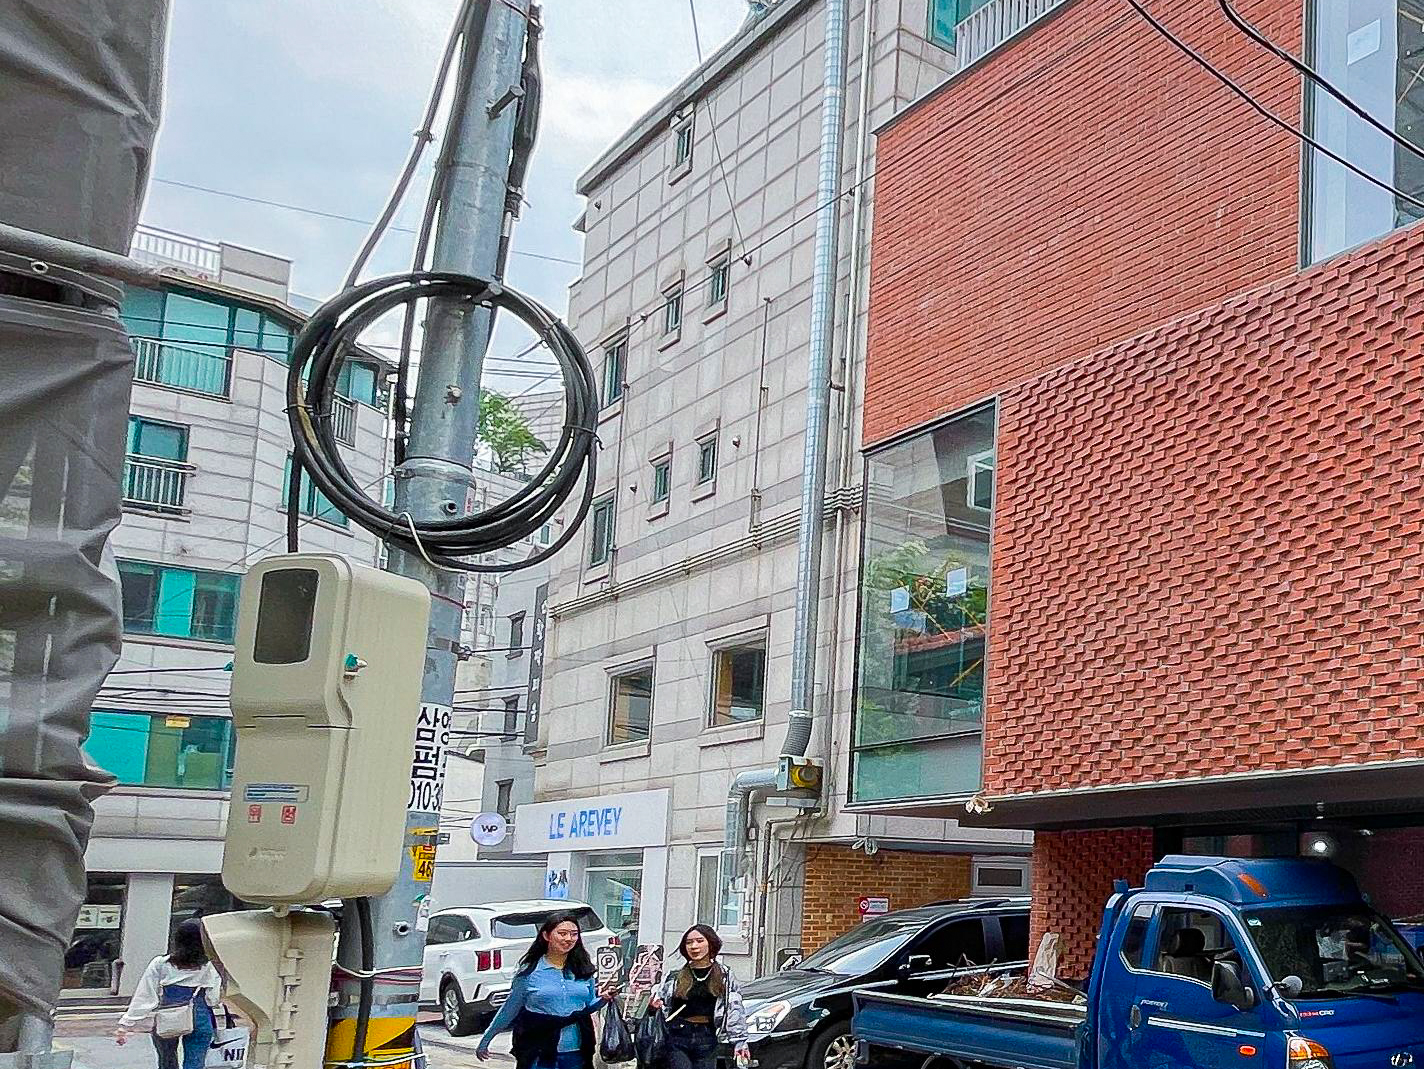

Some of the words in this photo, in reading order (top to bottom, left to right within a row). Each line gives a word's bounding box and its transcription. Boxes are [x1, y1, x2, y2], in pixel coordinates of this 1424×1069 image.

[411, 745, 446, 781] 펌
[407, 780, 443, 812] 10-3
[549, 812, 566, 840] LE
[569, 807, 623, 839] AREVEY
